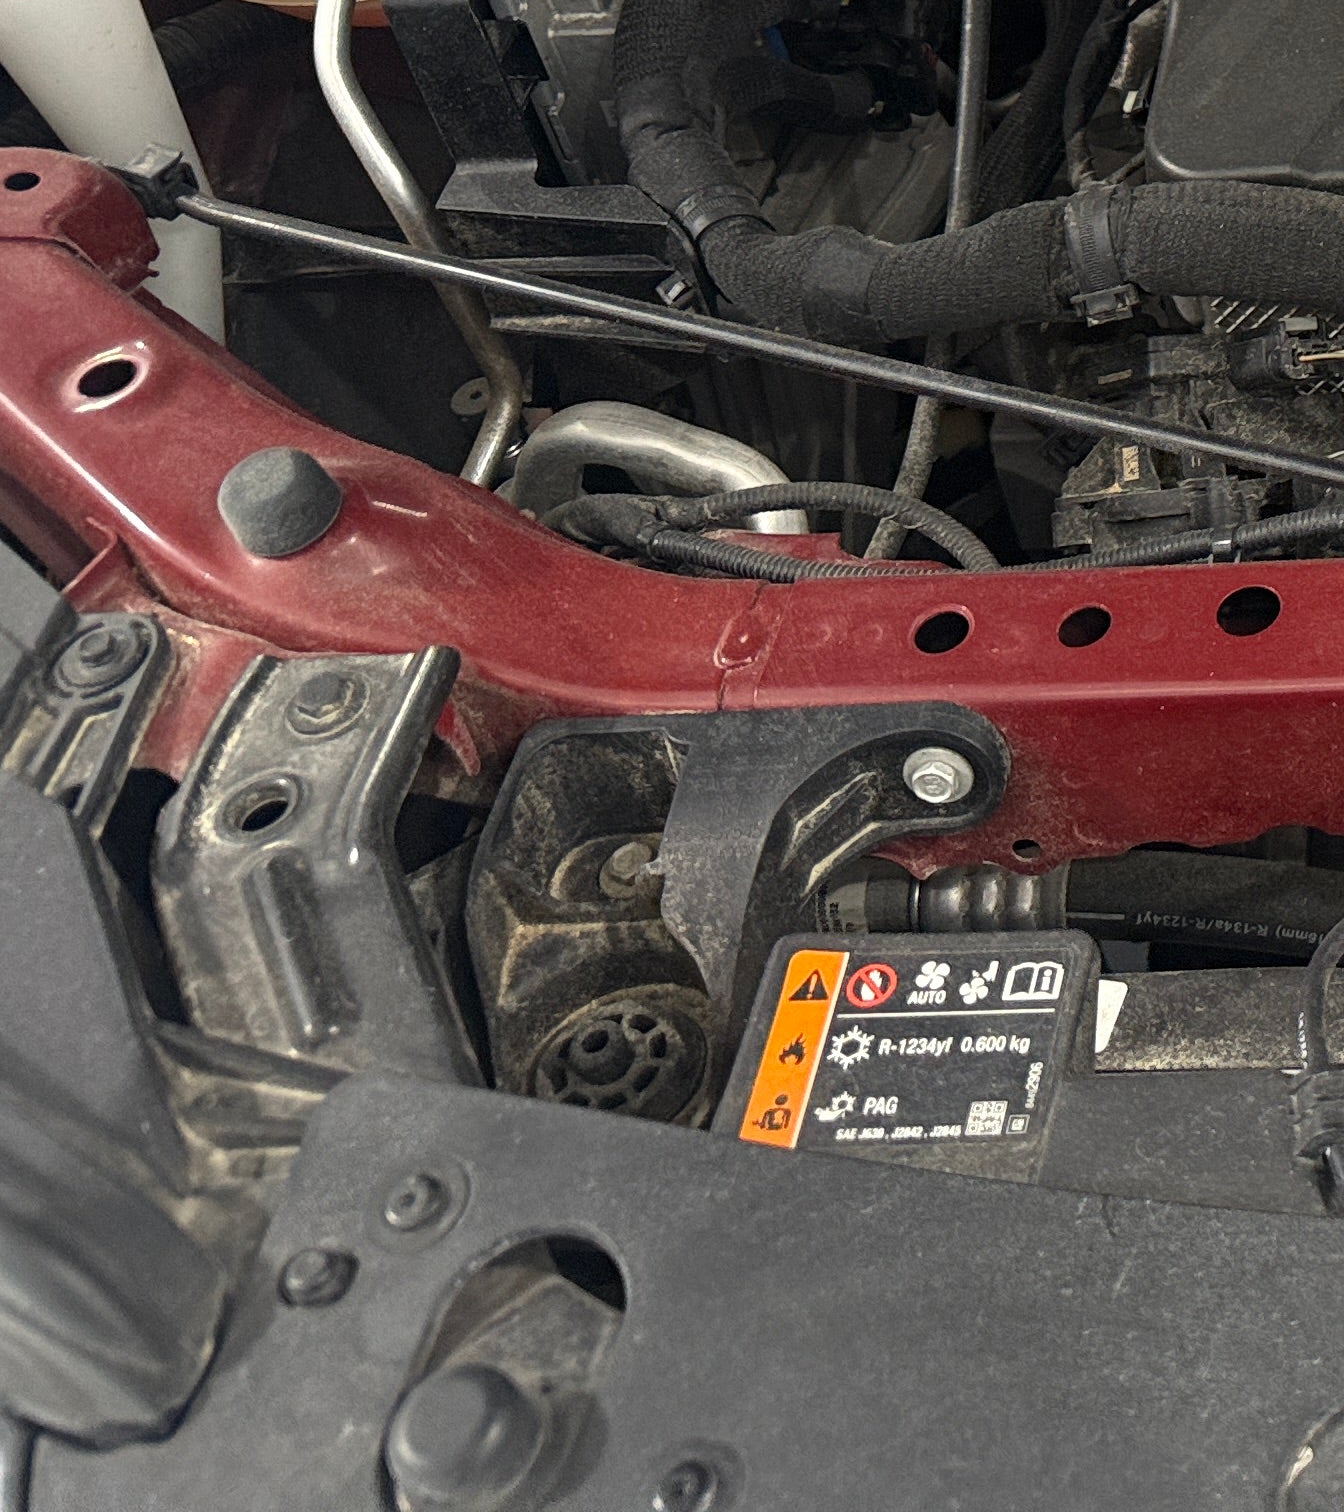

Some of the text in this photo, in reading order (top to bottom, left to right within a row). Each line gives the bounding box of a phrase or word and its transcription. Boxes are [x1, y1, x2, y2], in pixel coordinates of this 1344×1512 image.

[907, 990, 947, 1005] AUTO
[878, 1035, 1030, 1057] R-1234yf 0.600 kg
[863, 1097, 899, 1116] PAG
[835, 1128, 858, 1140] SAE
